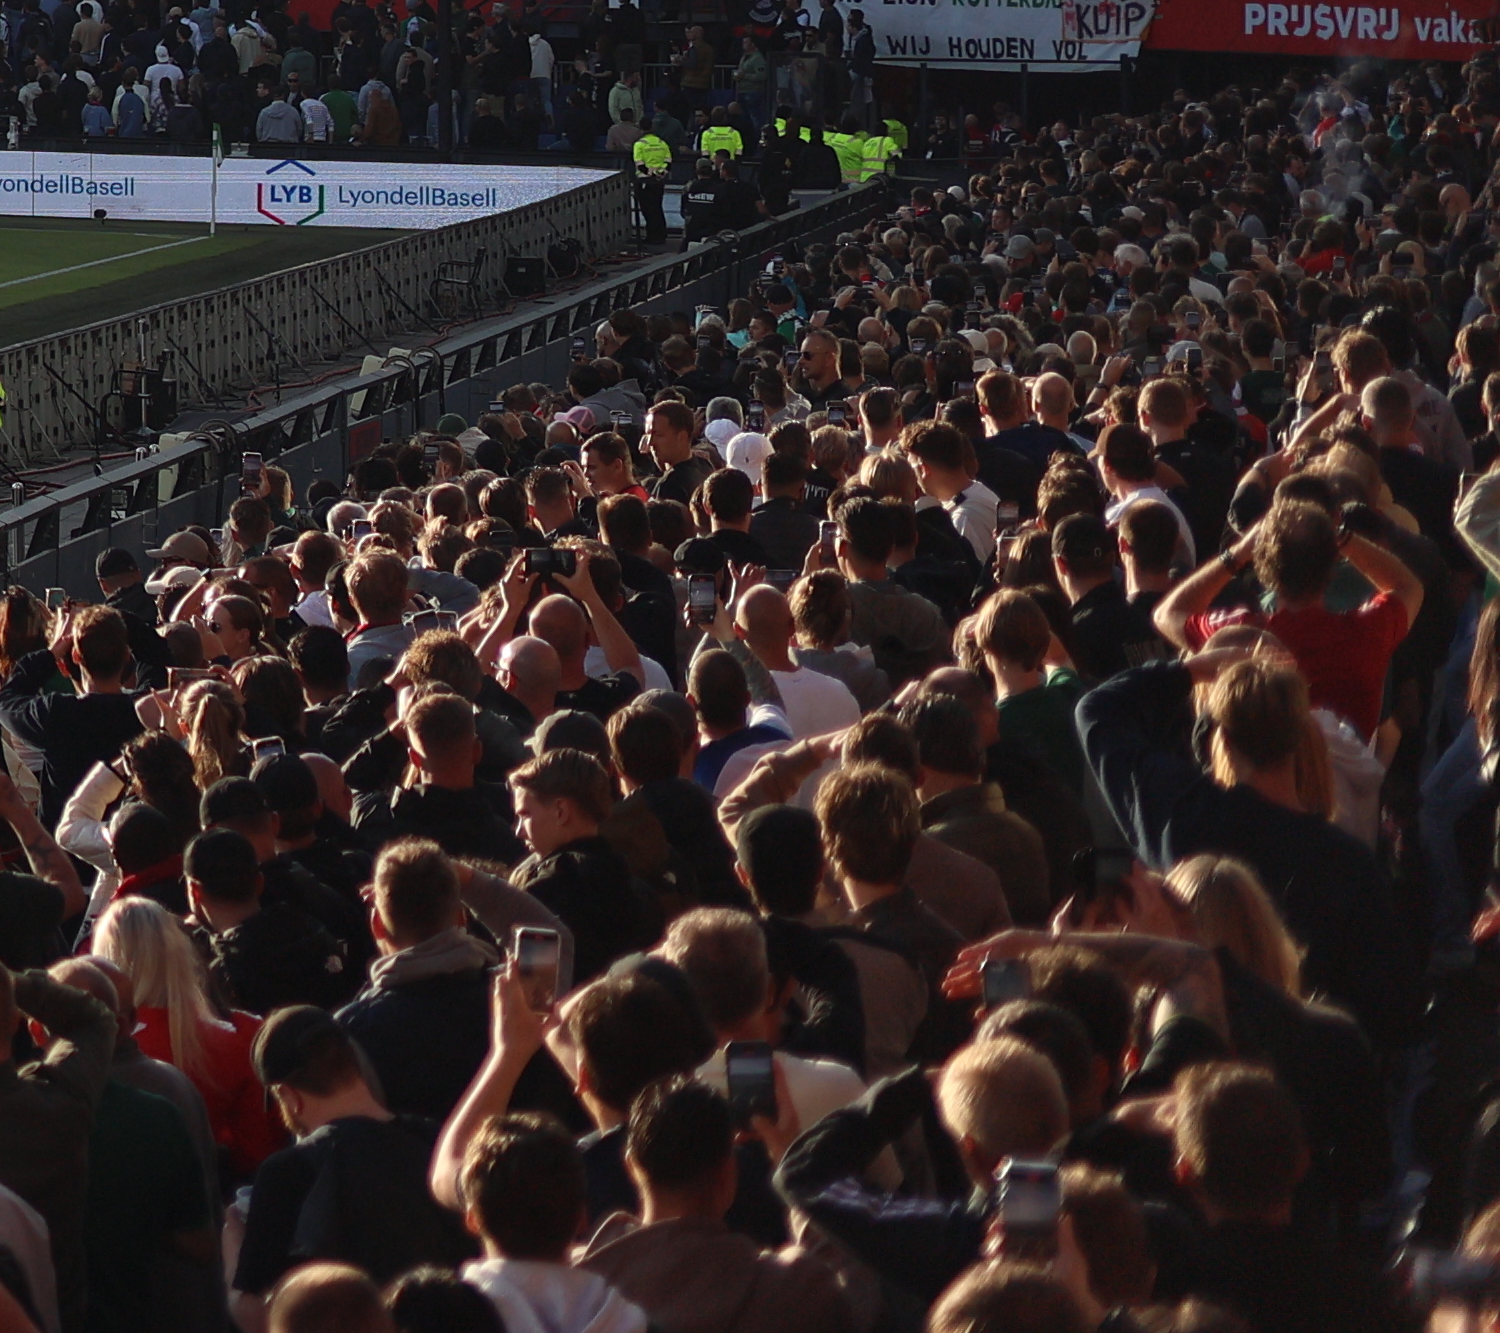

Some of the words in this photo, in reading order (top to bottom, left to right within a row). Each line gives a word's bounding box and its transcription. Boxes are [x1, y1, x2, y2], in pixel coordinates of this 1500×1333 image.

[1075, 2, 1146, 39] KUIP
[886, 35, 931, 56] WIJ
[948, 36, 1035, 60] HOUDEN
[1052, 40, 1088, 61] VOL
[269, 184, 313, 204] LYB
[337, 185, 497, 211] LyondellBasell
